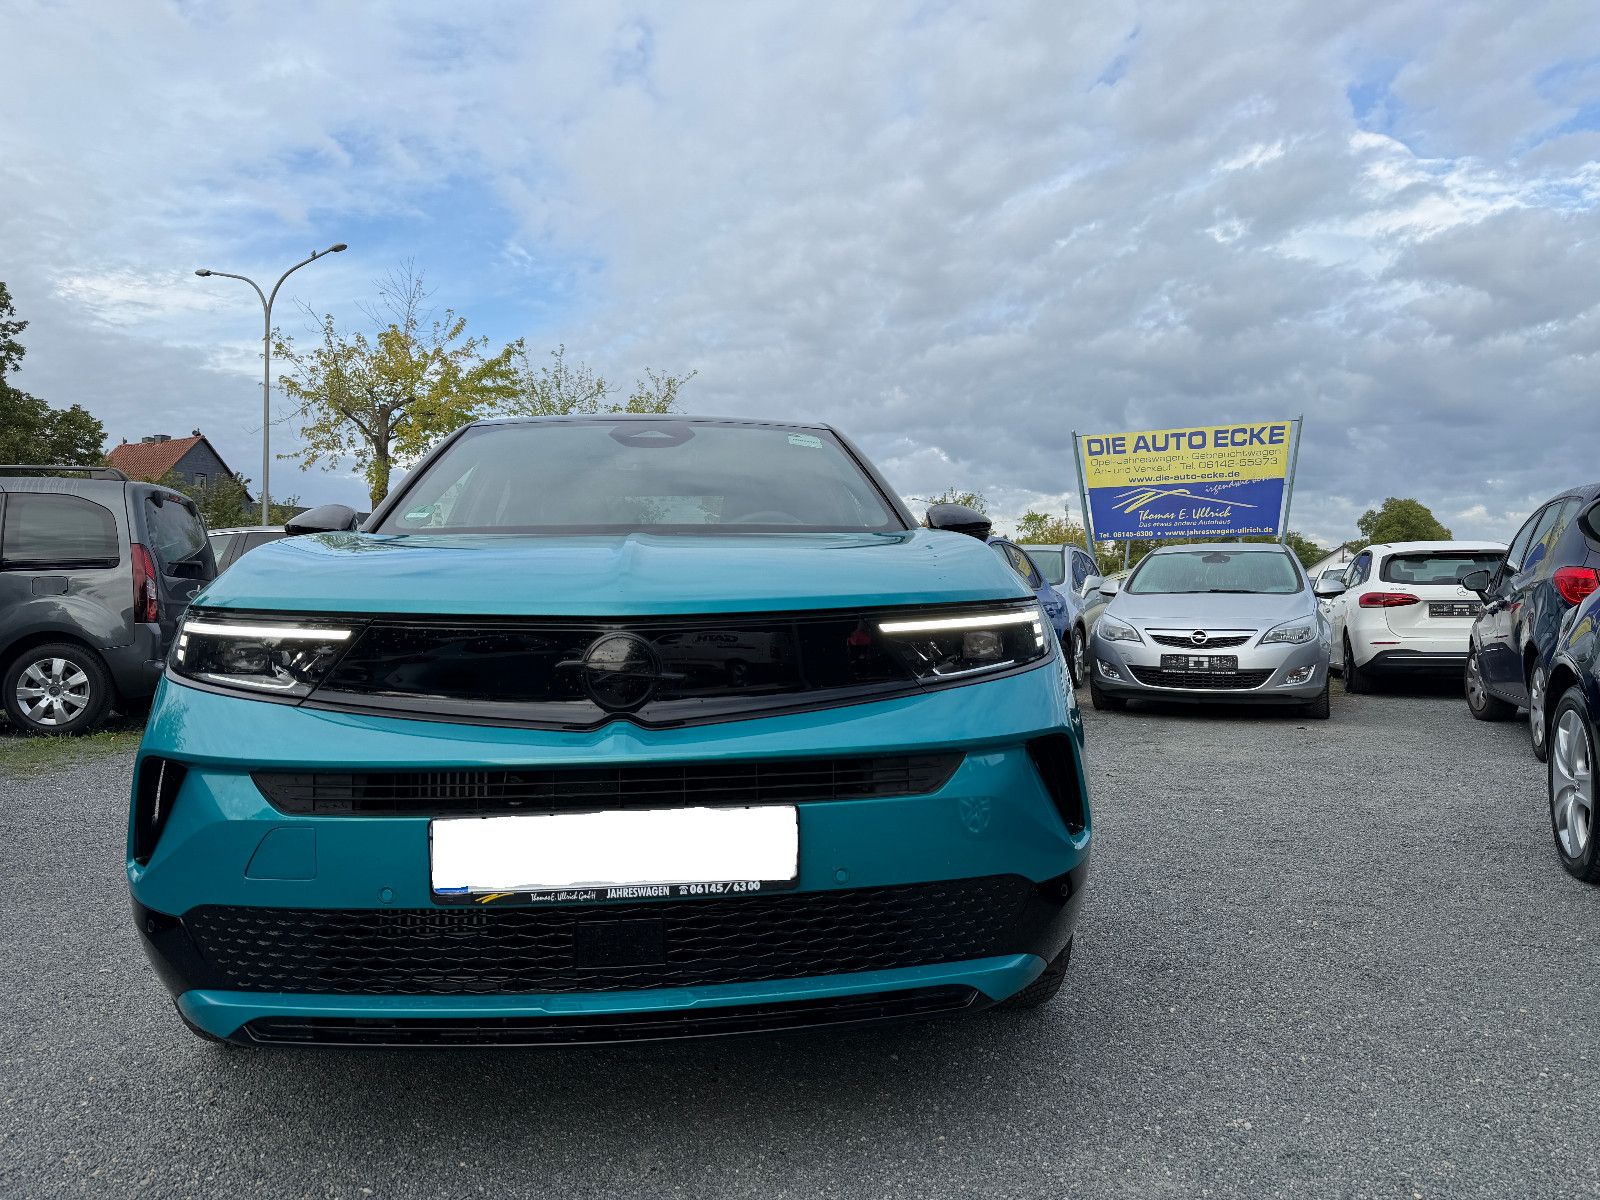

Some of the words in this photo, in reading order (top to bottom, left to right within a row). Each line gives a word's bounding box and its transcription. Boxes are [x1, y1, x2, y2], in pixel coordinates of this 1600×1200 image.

[1087, 437, 1126, 456] DIE
[1133, 431, 1206, 454] AUTO
[1214, 426, 1286, 448] ECKE
[1192, 449, 1282, 460] Gebrauchtwagen
[1179, 462, 1196, 470] Tel.
[1198, 457, 1278, 469] 06142-55973
[1128, 471, 1240, 482] www.die-auto-ecke.de
[1138, 509, 1176, 521] Thomas
[1179, 508, 1189, 520] E.
[1192, 505, 1232, 519] Ullrich
[1113, 530, 1154, 539] 06145-6300
[1164, 526, 1273, 537] www.jahreswagen-ullrich.de
[606, 886, 670, 898] JAHRESWAGEN
